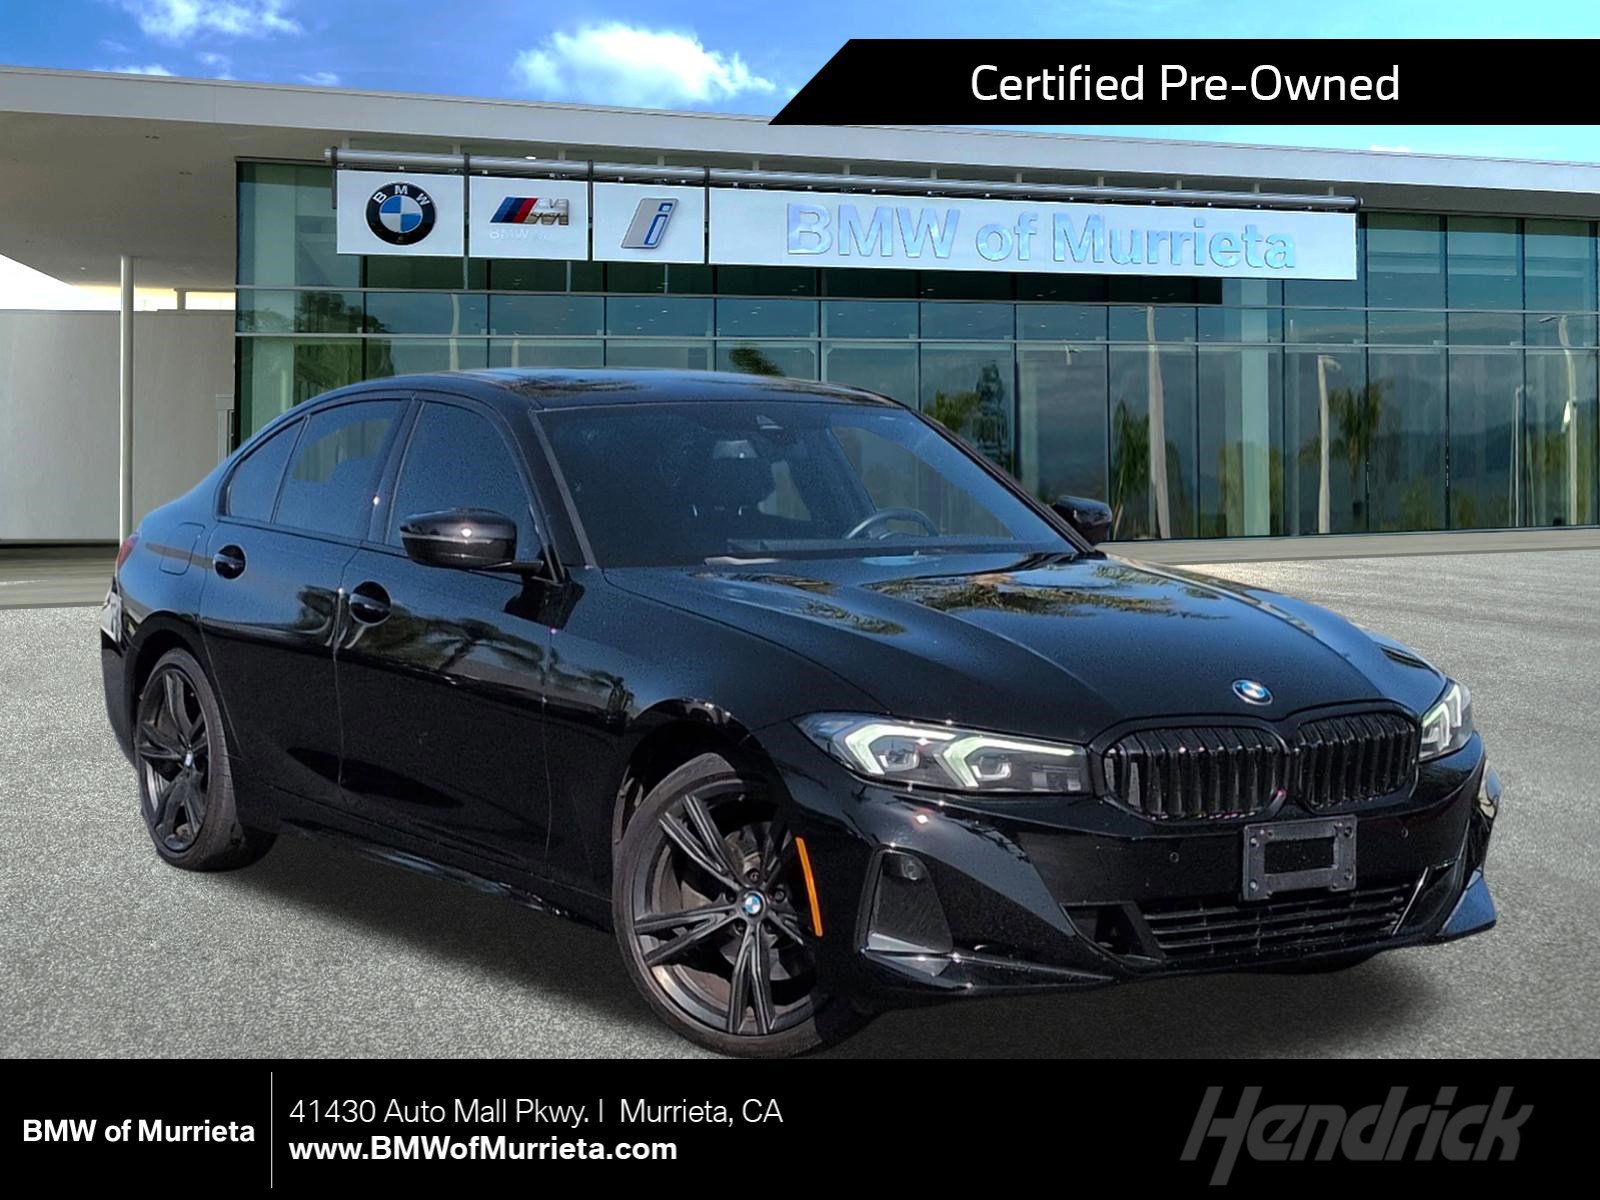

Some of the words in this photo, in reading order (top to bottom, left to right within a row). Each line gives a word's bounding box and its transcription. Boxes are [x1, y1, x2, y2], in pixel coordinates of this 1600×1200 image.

[372, 185, 431, 206] BMW
[787, 202, 961, 258] BMW
[975, 211, 1038, 262] of
[1052, 212, 1296, 269] Murrieta
